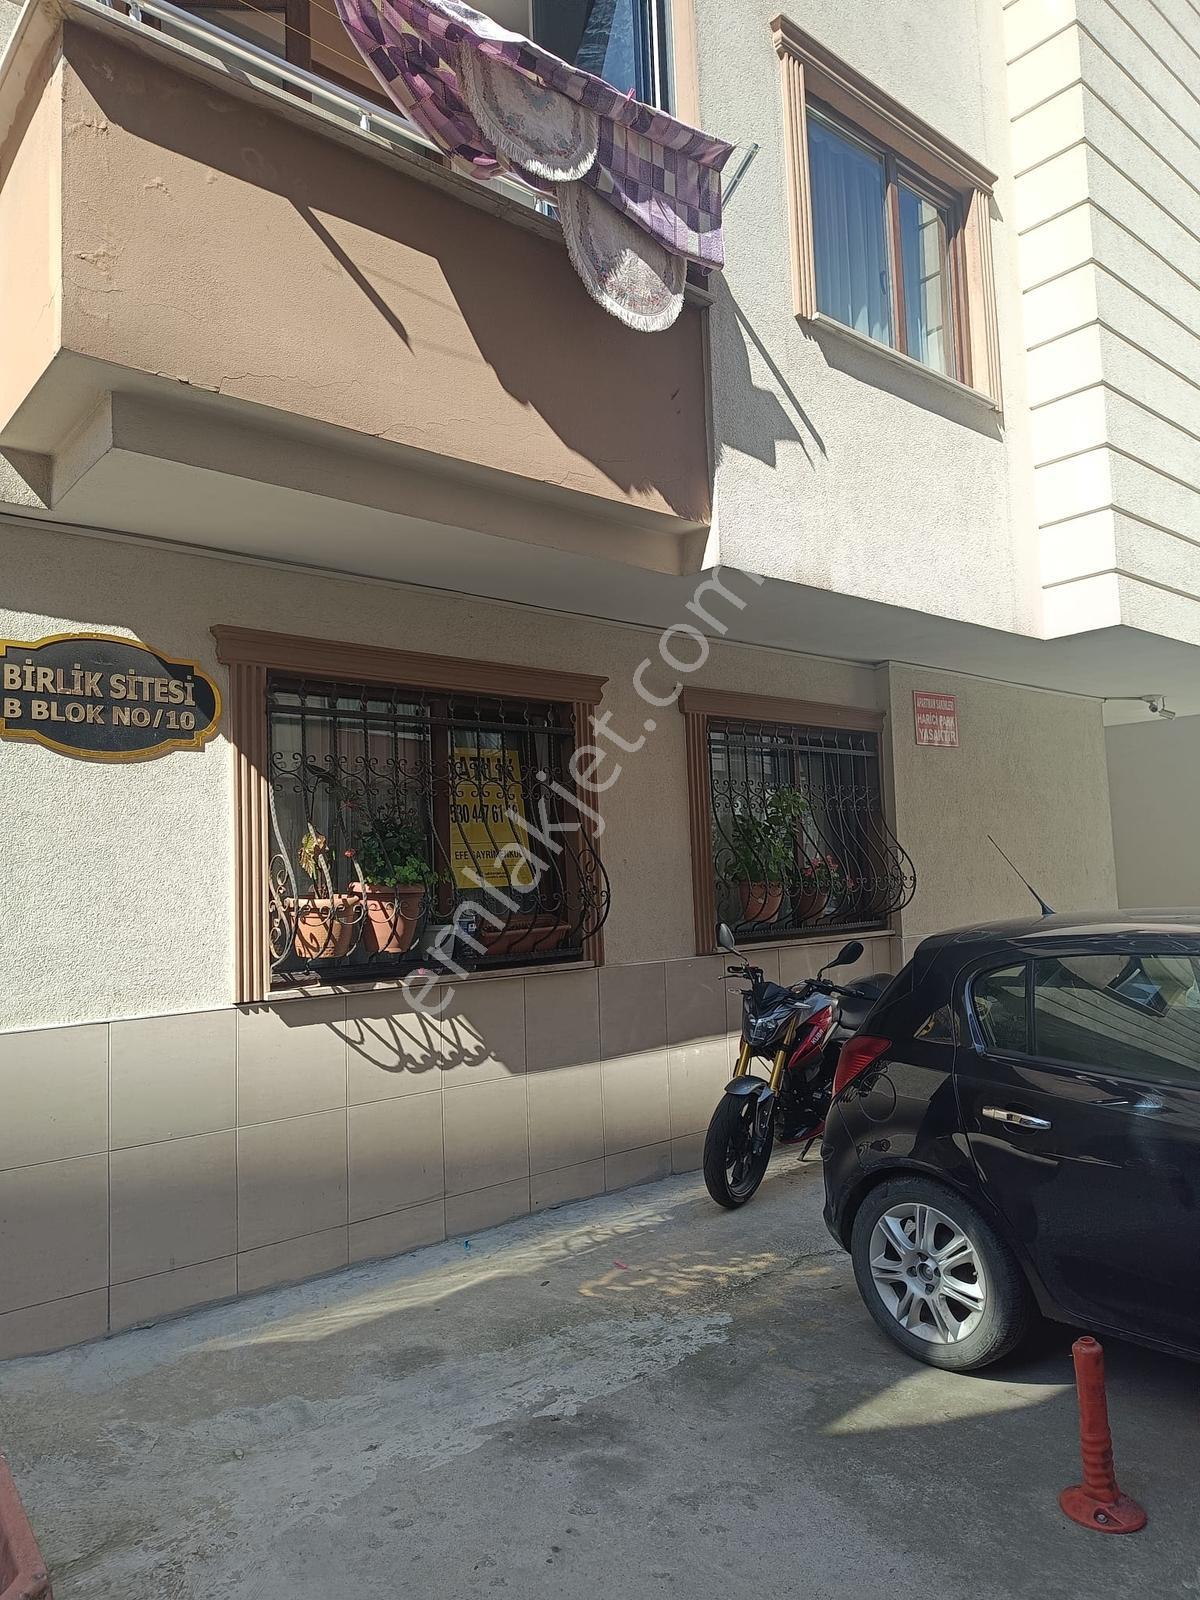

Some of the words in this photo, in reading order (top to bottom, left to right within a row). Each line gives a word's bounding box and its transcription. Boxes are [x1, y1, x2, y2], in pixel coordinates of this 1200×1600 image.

[3, 659, 104, 698] BİRLİK
[109, 668, 196, 707] SİTESİ
[3, 697, 22, 719] B
[31, 699, 105, 725] BLOK
[112, 705, 196, 731] NO/10
[491, 803, 504, 824] 61
[455, 850, 469, 860] EFE
